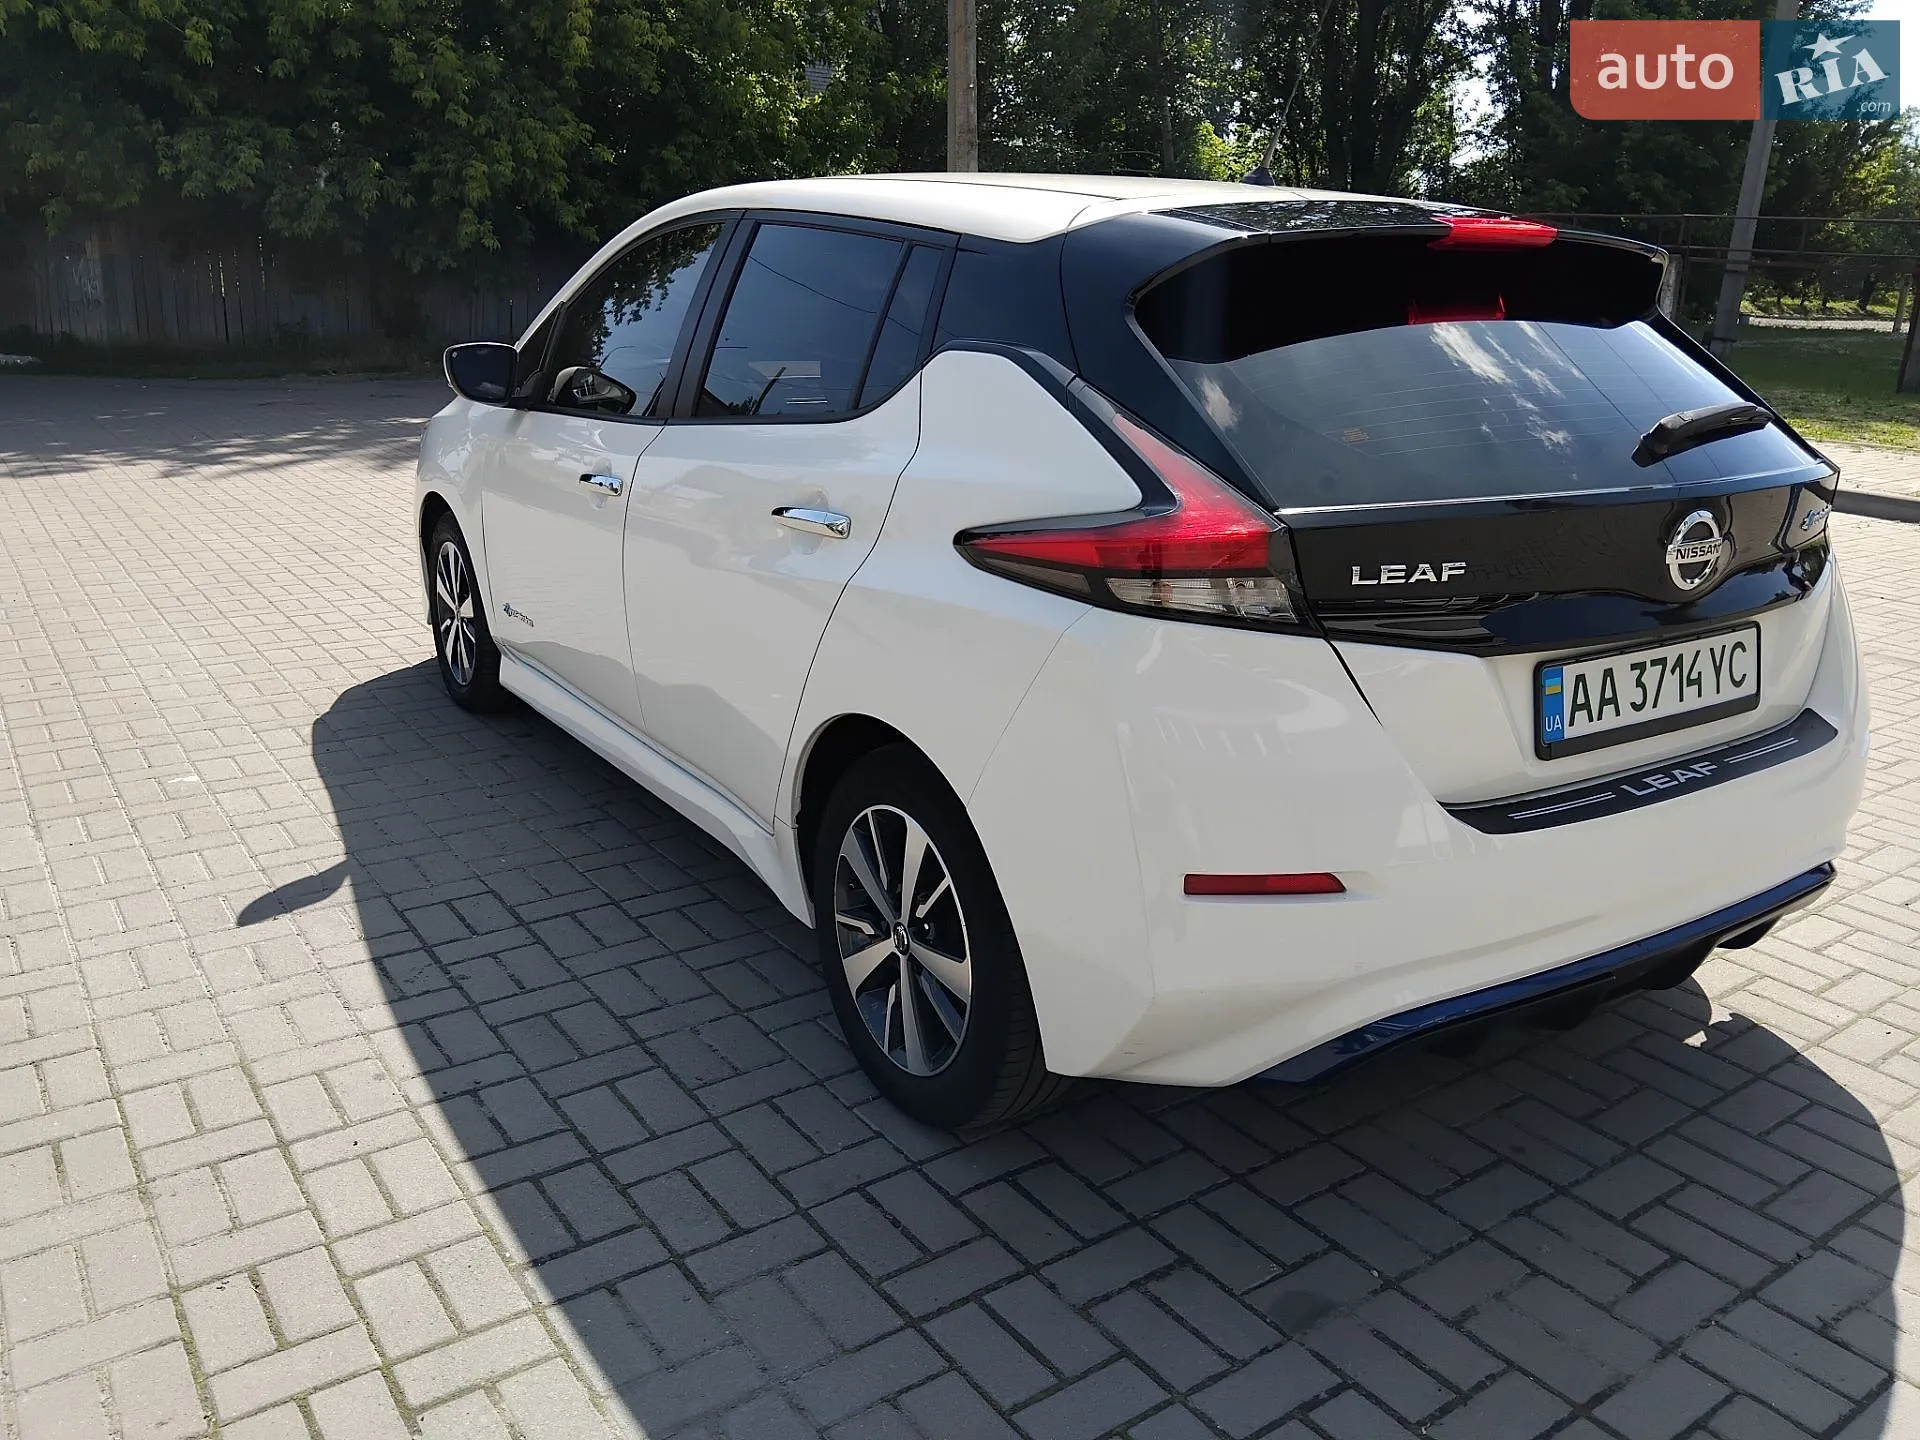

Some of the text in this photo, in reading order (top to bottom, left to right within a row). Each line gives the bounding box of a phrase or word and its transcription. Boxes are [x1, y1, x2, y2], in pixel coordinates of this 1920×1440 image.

[1676, 542, 1721, 560] NISSAN
[1351, 561, 1467, 585] LEAF
[1568, 641, 1747, 727] AA 3714 YC
[1545, 714, 1563, 733] UA
[1620, 761, 1718, 796] LEAF
